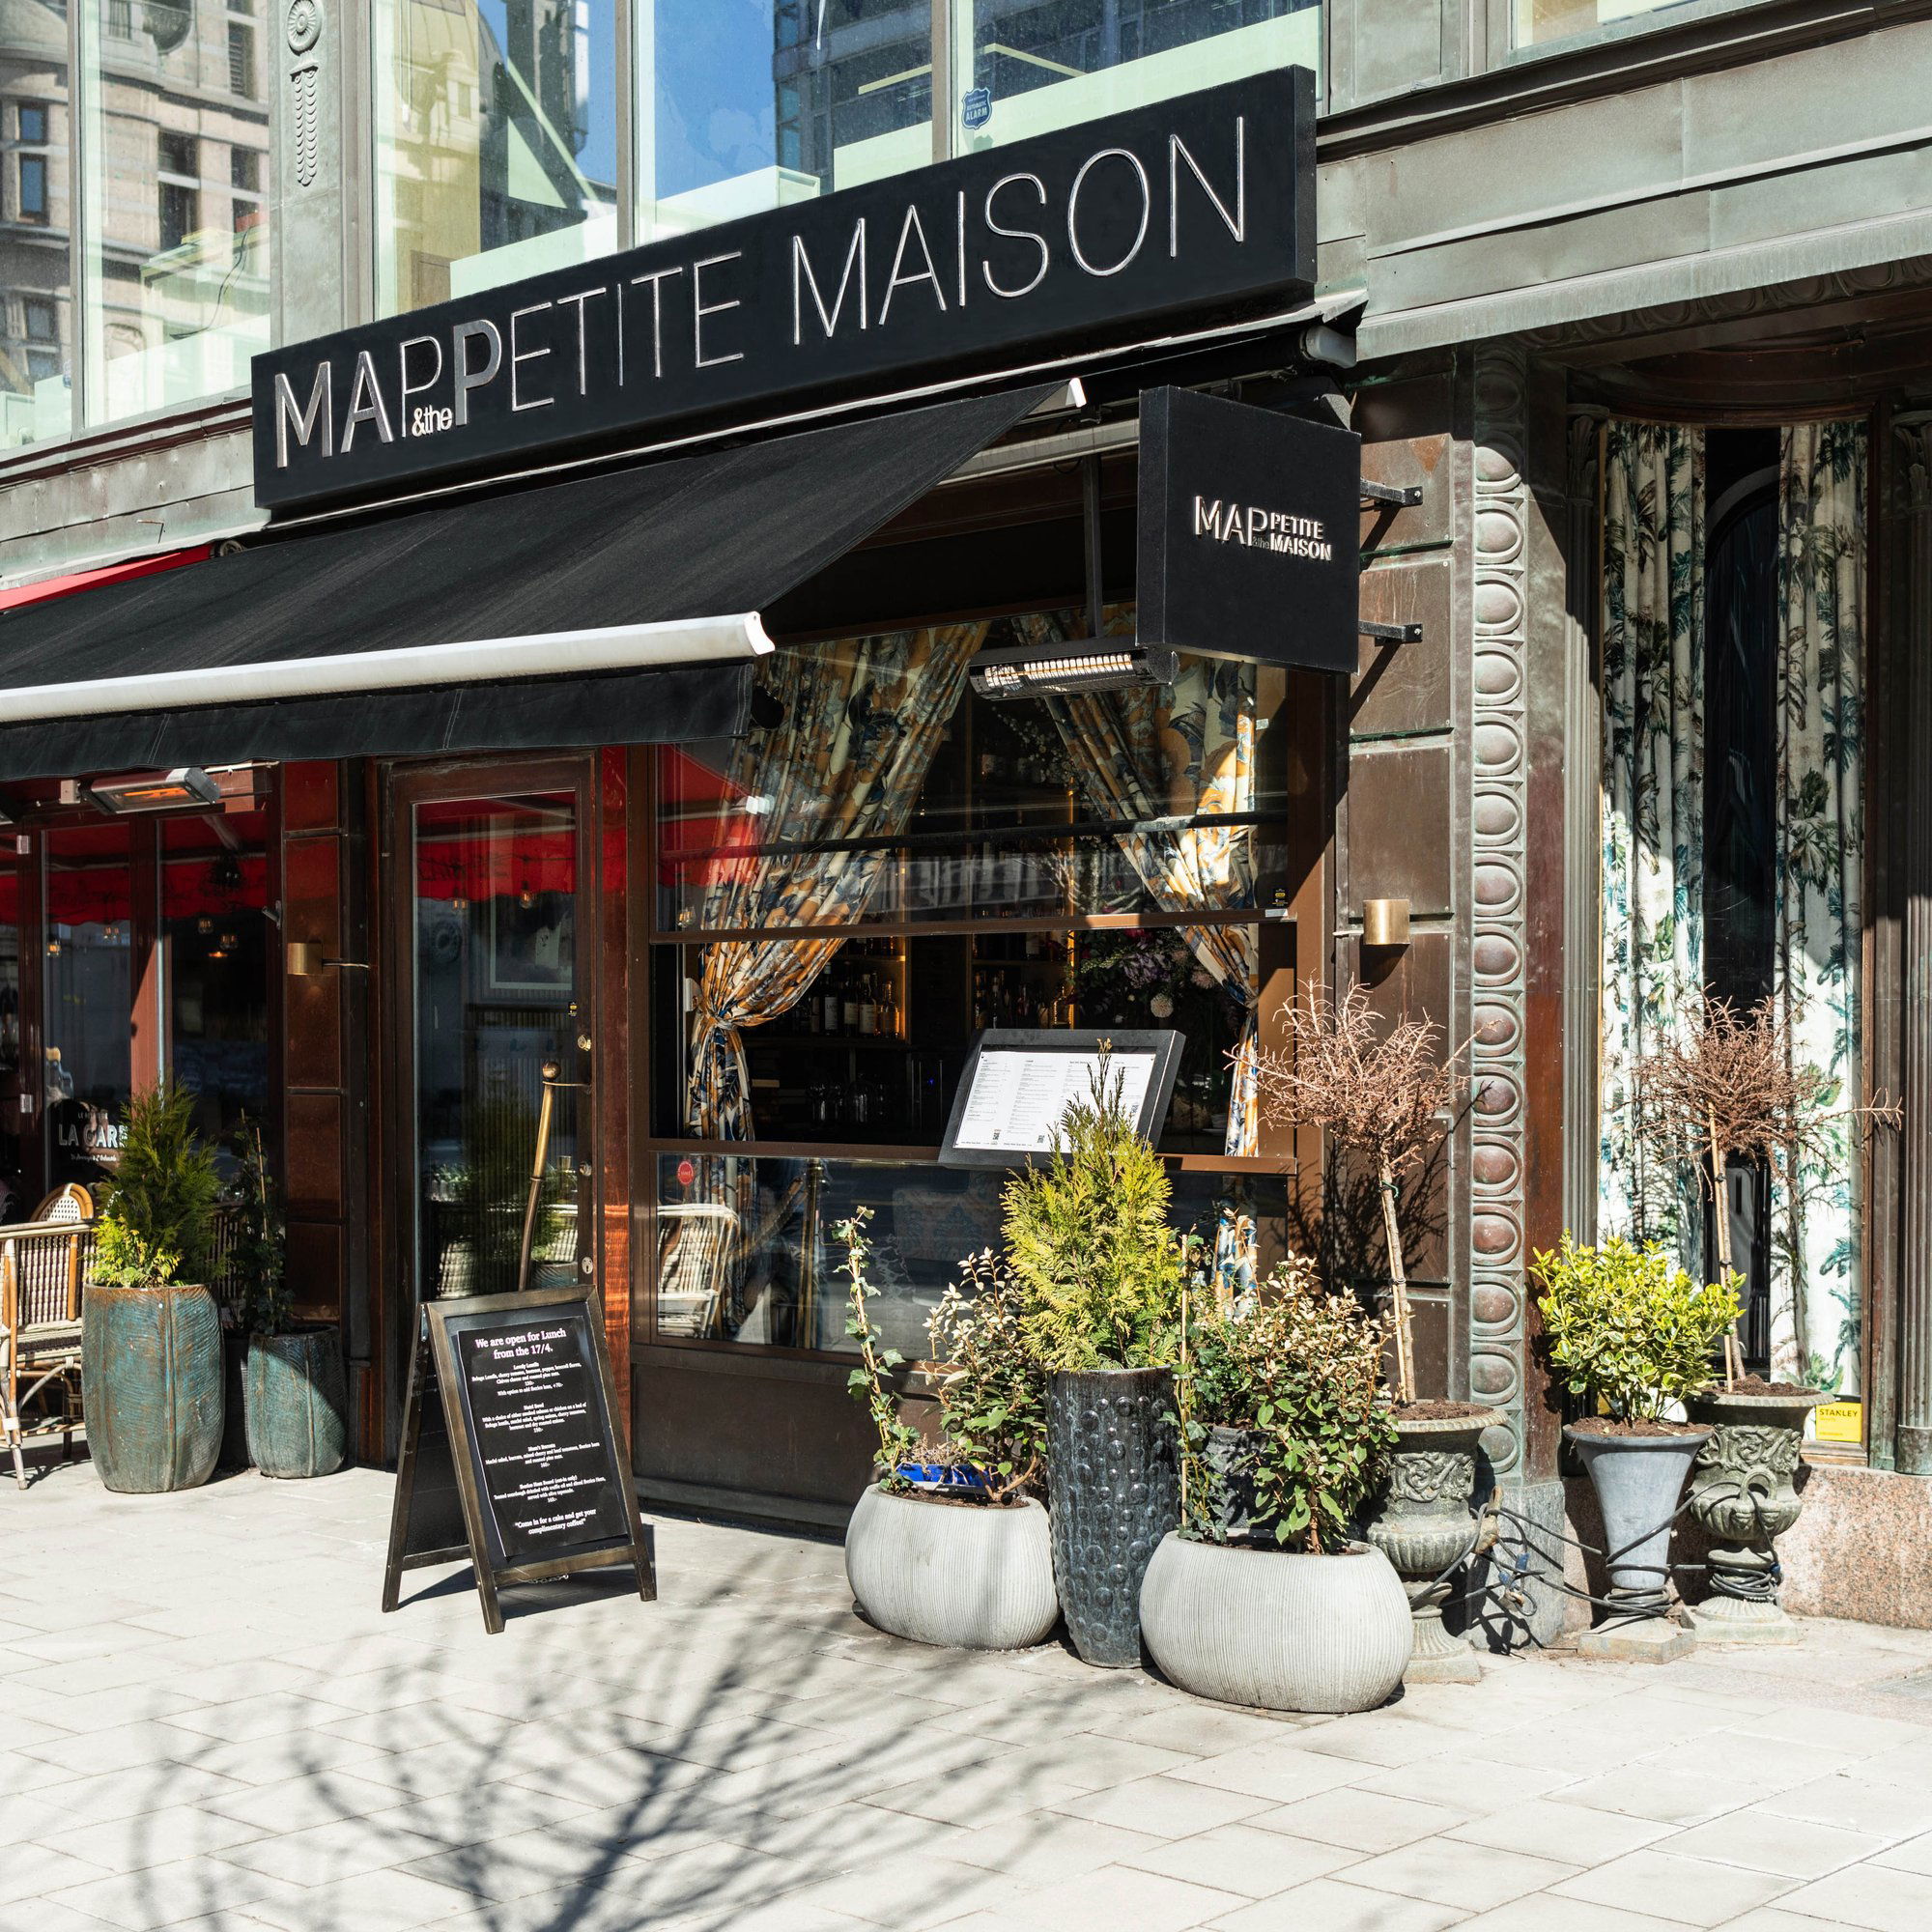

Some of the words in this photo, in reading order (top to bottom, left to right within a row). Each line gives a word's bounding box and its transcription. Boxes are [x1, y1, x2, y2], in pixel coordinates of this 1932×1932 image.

[966, 107, 987, 122] ALARM
[793, 116, 1246, 346] MAISON
[412, 402, 453, 437] &the
[1194, 495, 1268, 547] MAP
[1270, 512, 1323, 539] PETITE
[1270, 531, 1331, 561] MAISON
[59, 1124, 79, 1146] LA
[475, 1338, 489, 1348] We
[490, 1338, 504, 1347] are
[505, 1335, 527, 1346] open
[527, 1332, 540, 1342] for
[540, 1328, 567, 1340] Lunch
[493, 1349, 515, 1359] from
[515, 1346, 530, 1356] the
[530, 1343, 553, 1354] 17/4.
[1820, 1409, 1857, 1417] STANLEY
[584, 1509, 596, 1517] your
[528, 1523, 566, 1534] complimentary
